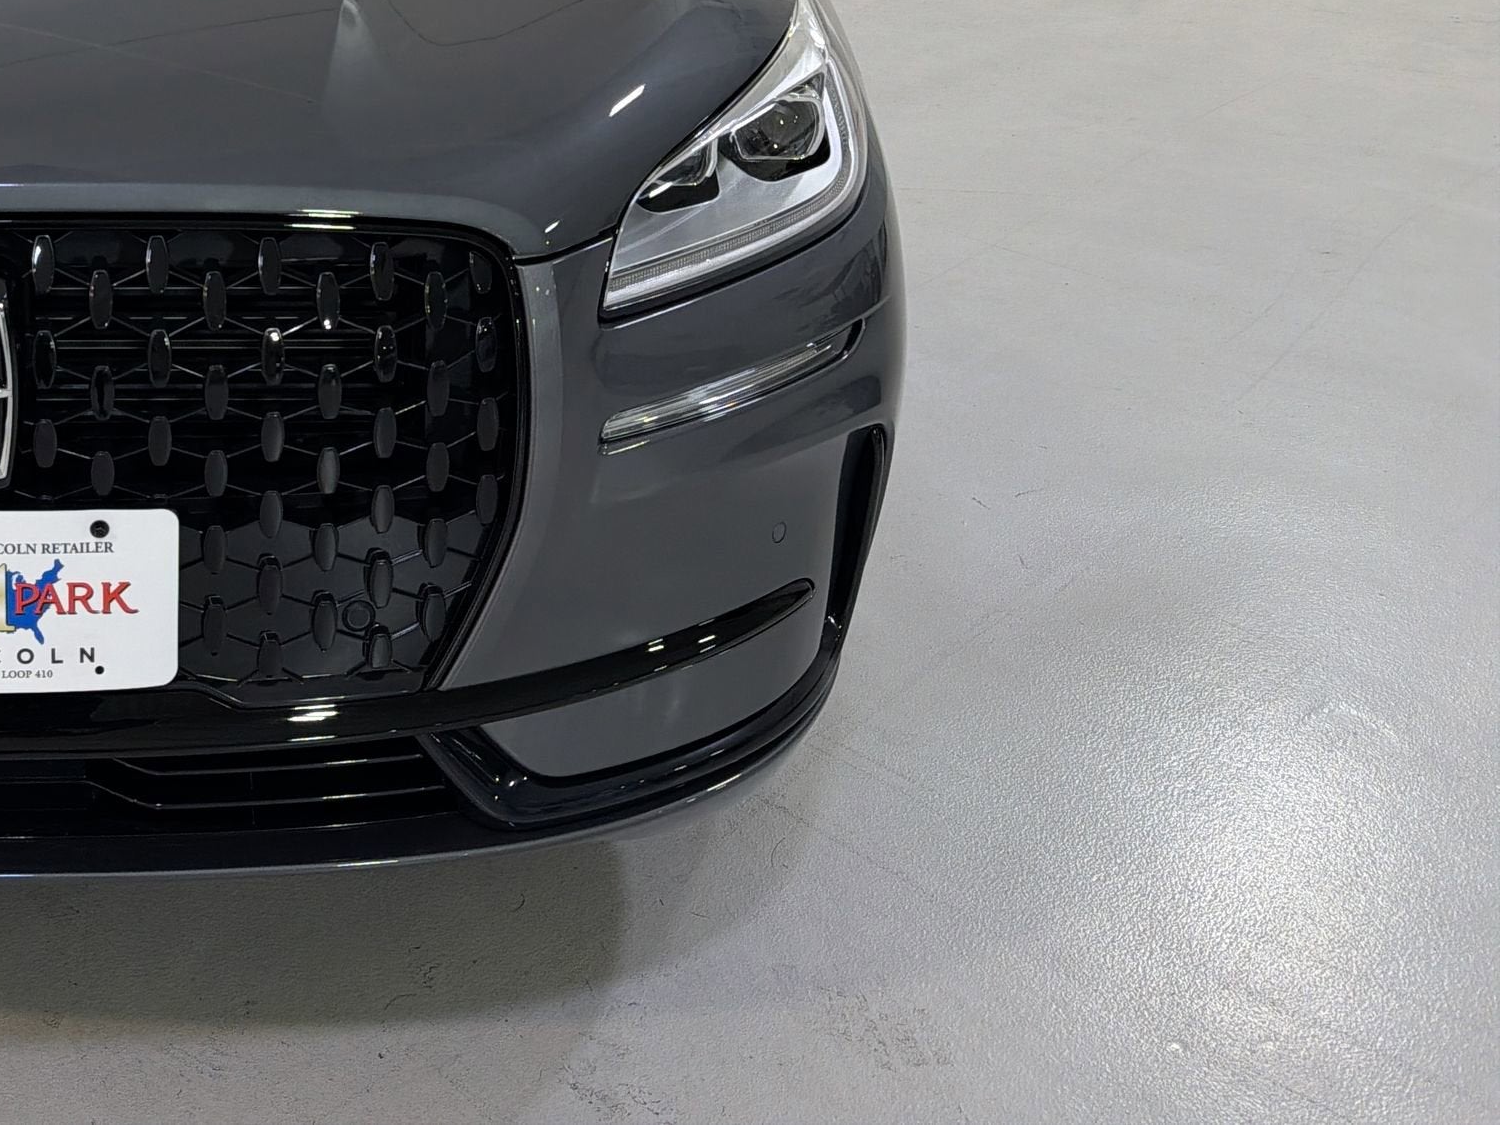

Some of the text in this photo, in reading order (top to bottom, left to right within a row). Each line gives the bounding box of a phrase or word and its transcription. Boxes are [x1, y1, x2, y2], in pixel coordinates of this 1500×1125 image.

[41, 542, 114, 554] RETAILER
[14, 581, 140, 615] PARK
[2, 670, 33, 679] LOOP
[35, 670, 53, 679] 410
